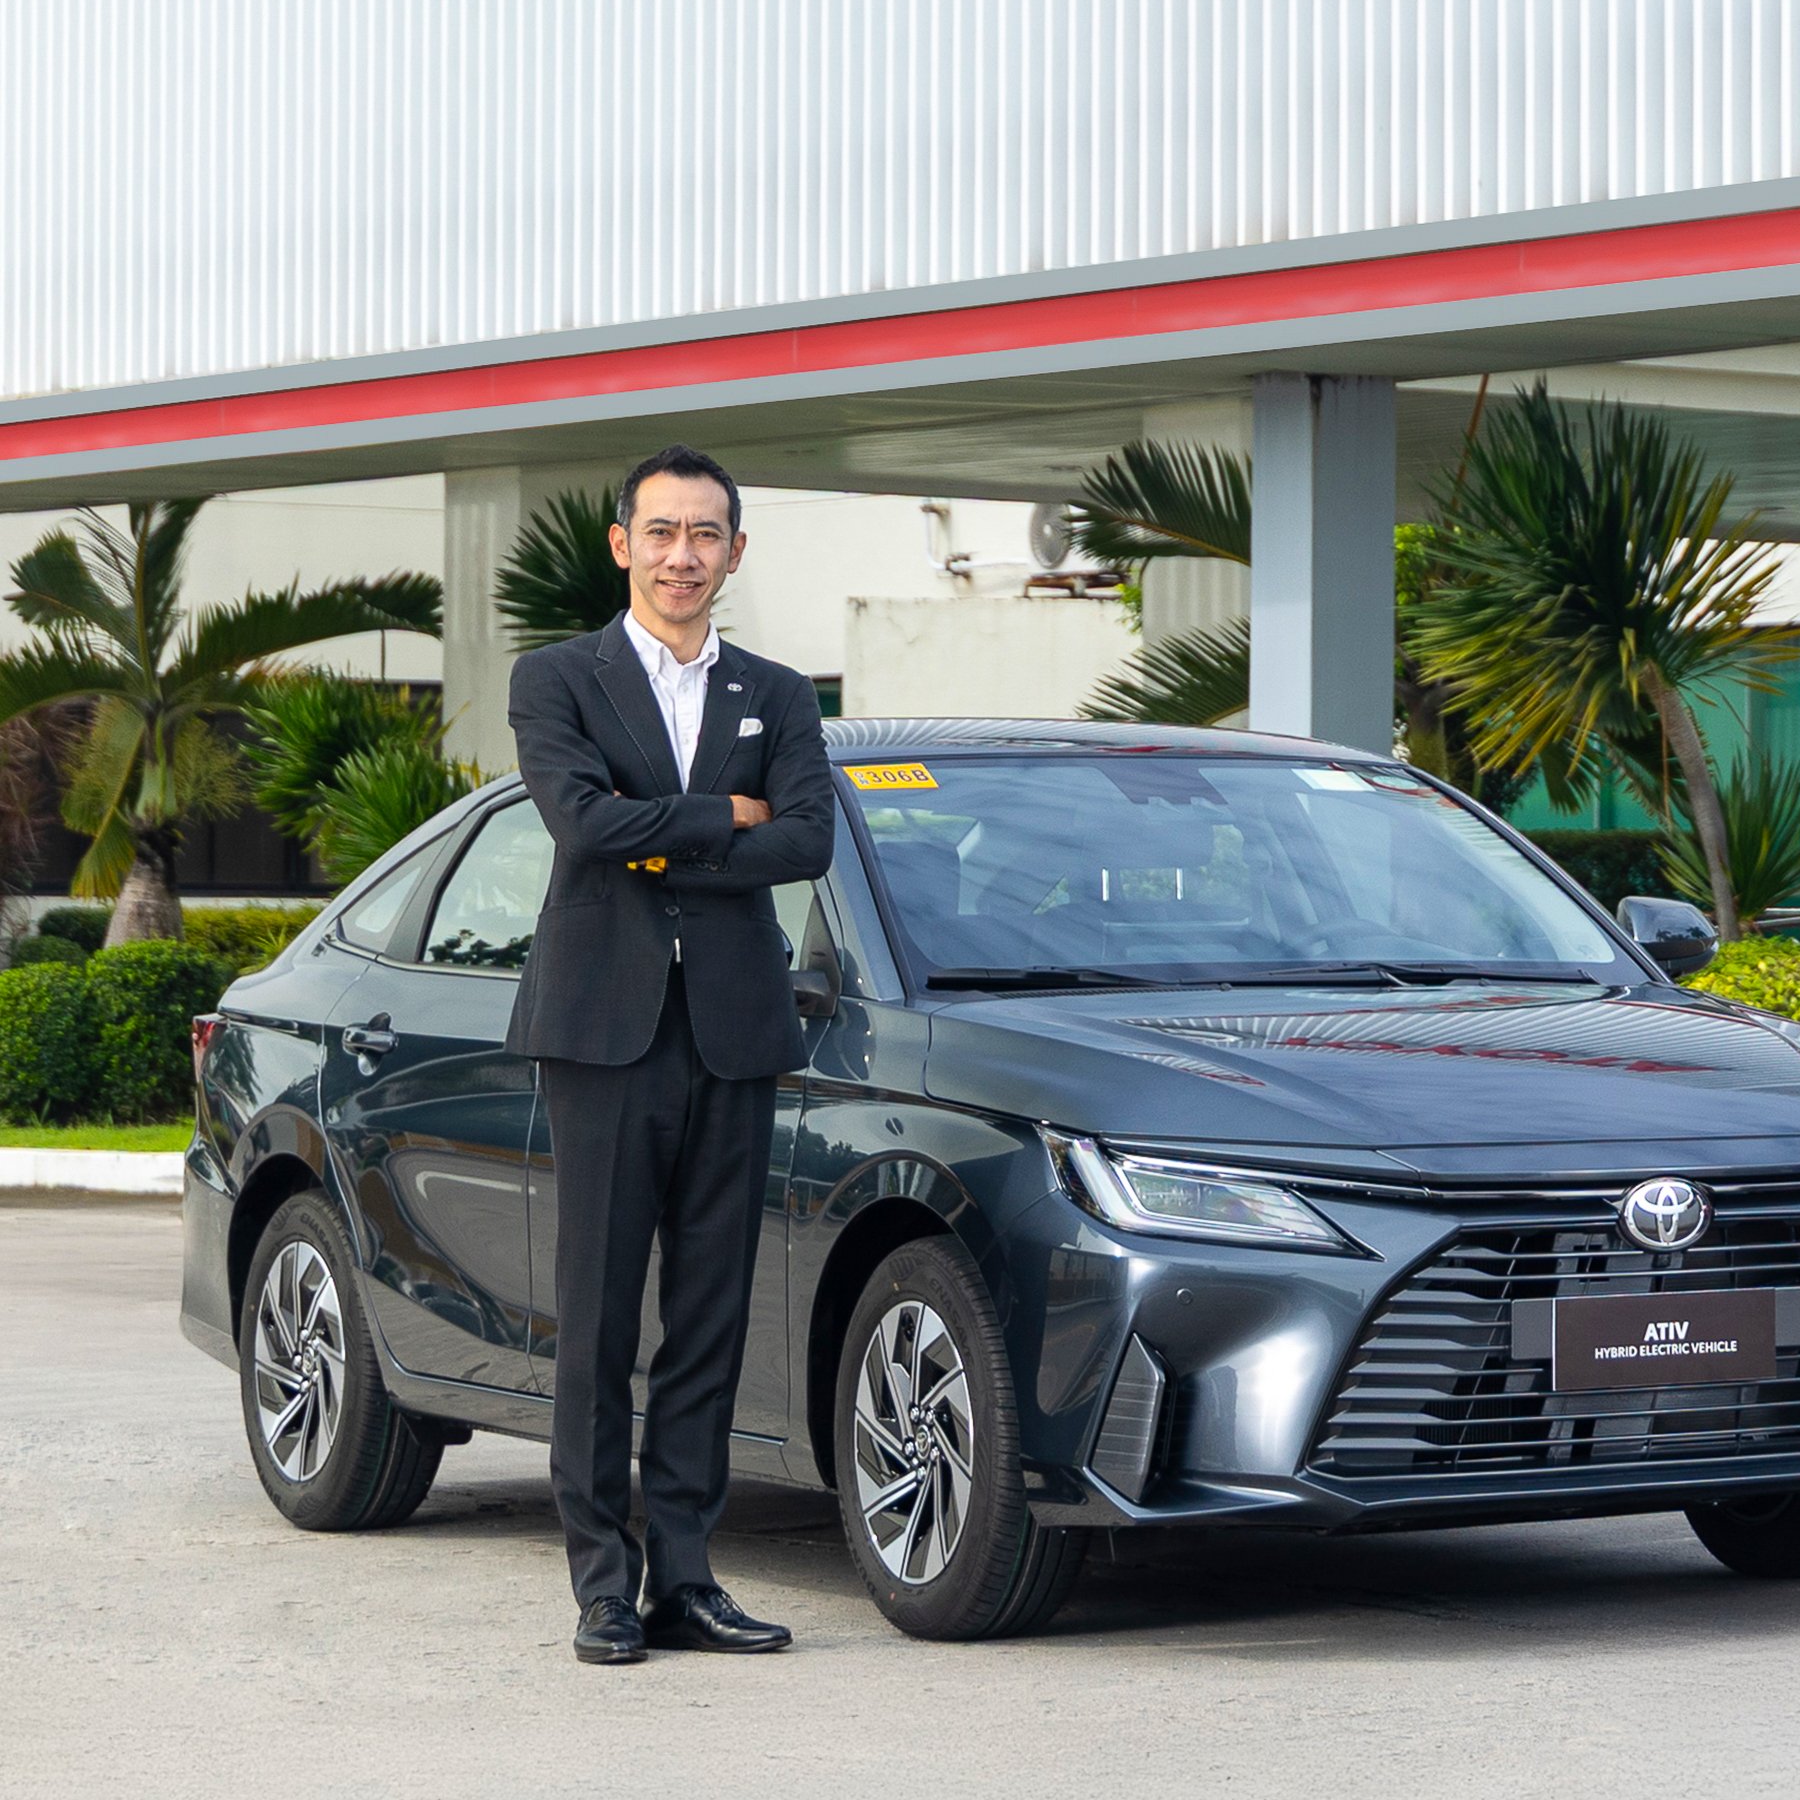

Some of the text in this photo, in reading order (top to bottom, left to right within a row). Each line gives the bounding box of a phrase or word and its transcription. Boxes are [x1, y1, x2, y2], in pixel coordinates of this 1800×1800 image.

[1643, 1321, 1690, 1341] ATIV
[1594, 1340, 1738, 1359] HYBRID ELECTRIC VEHICLE
